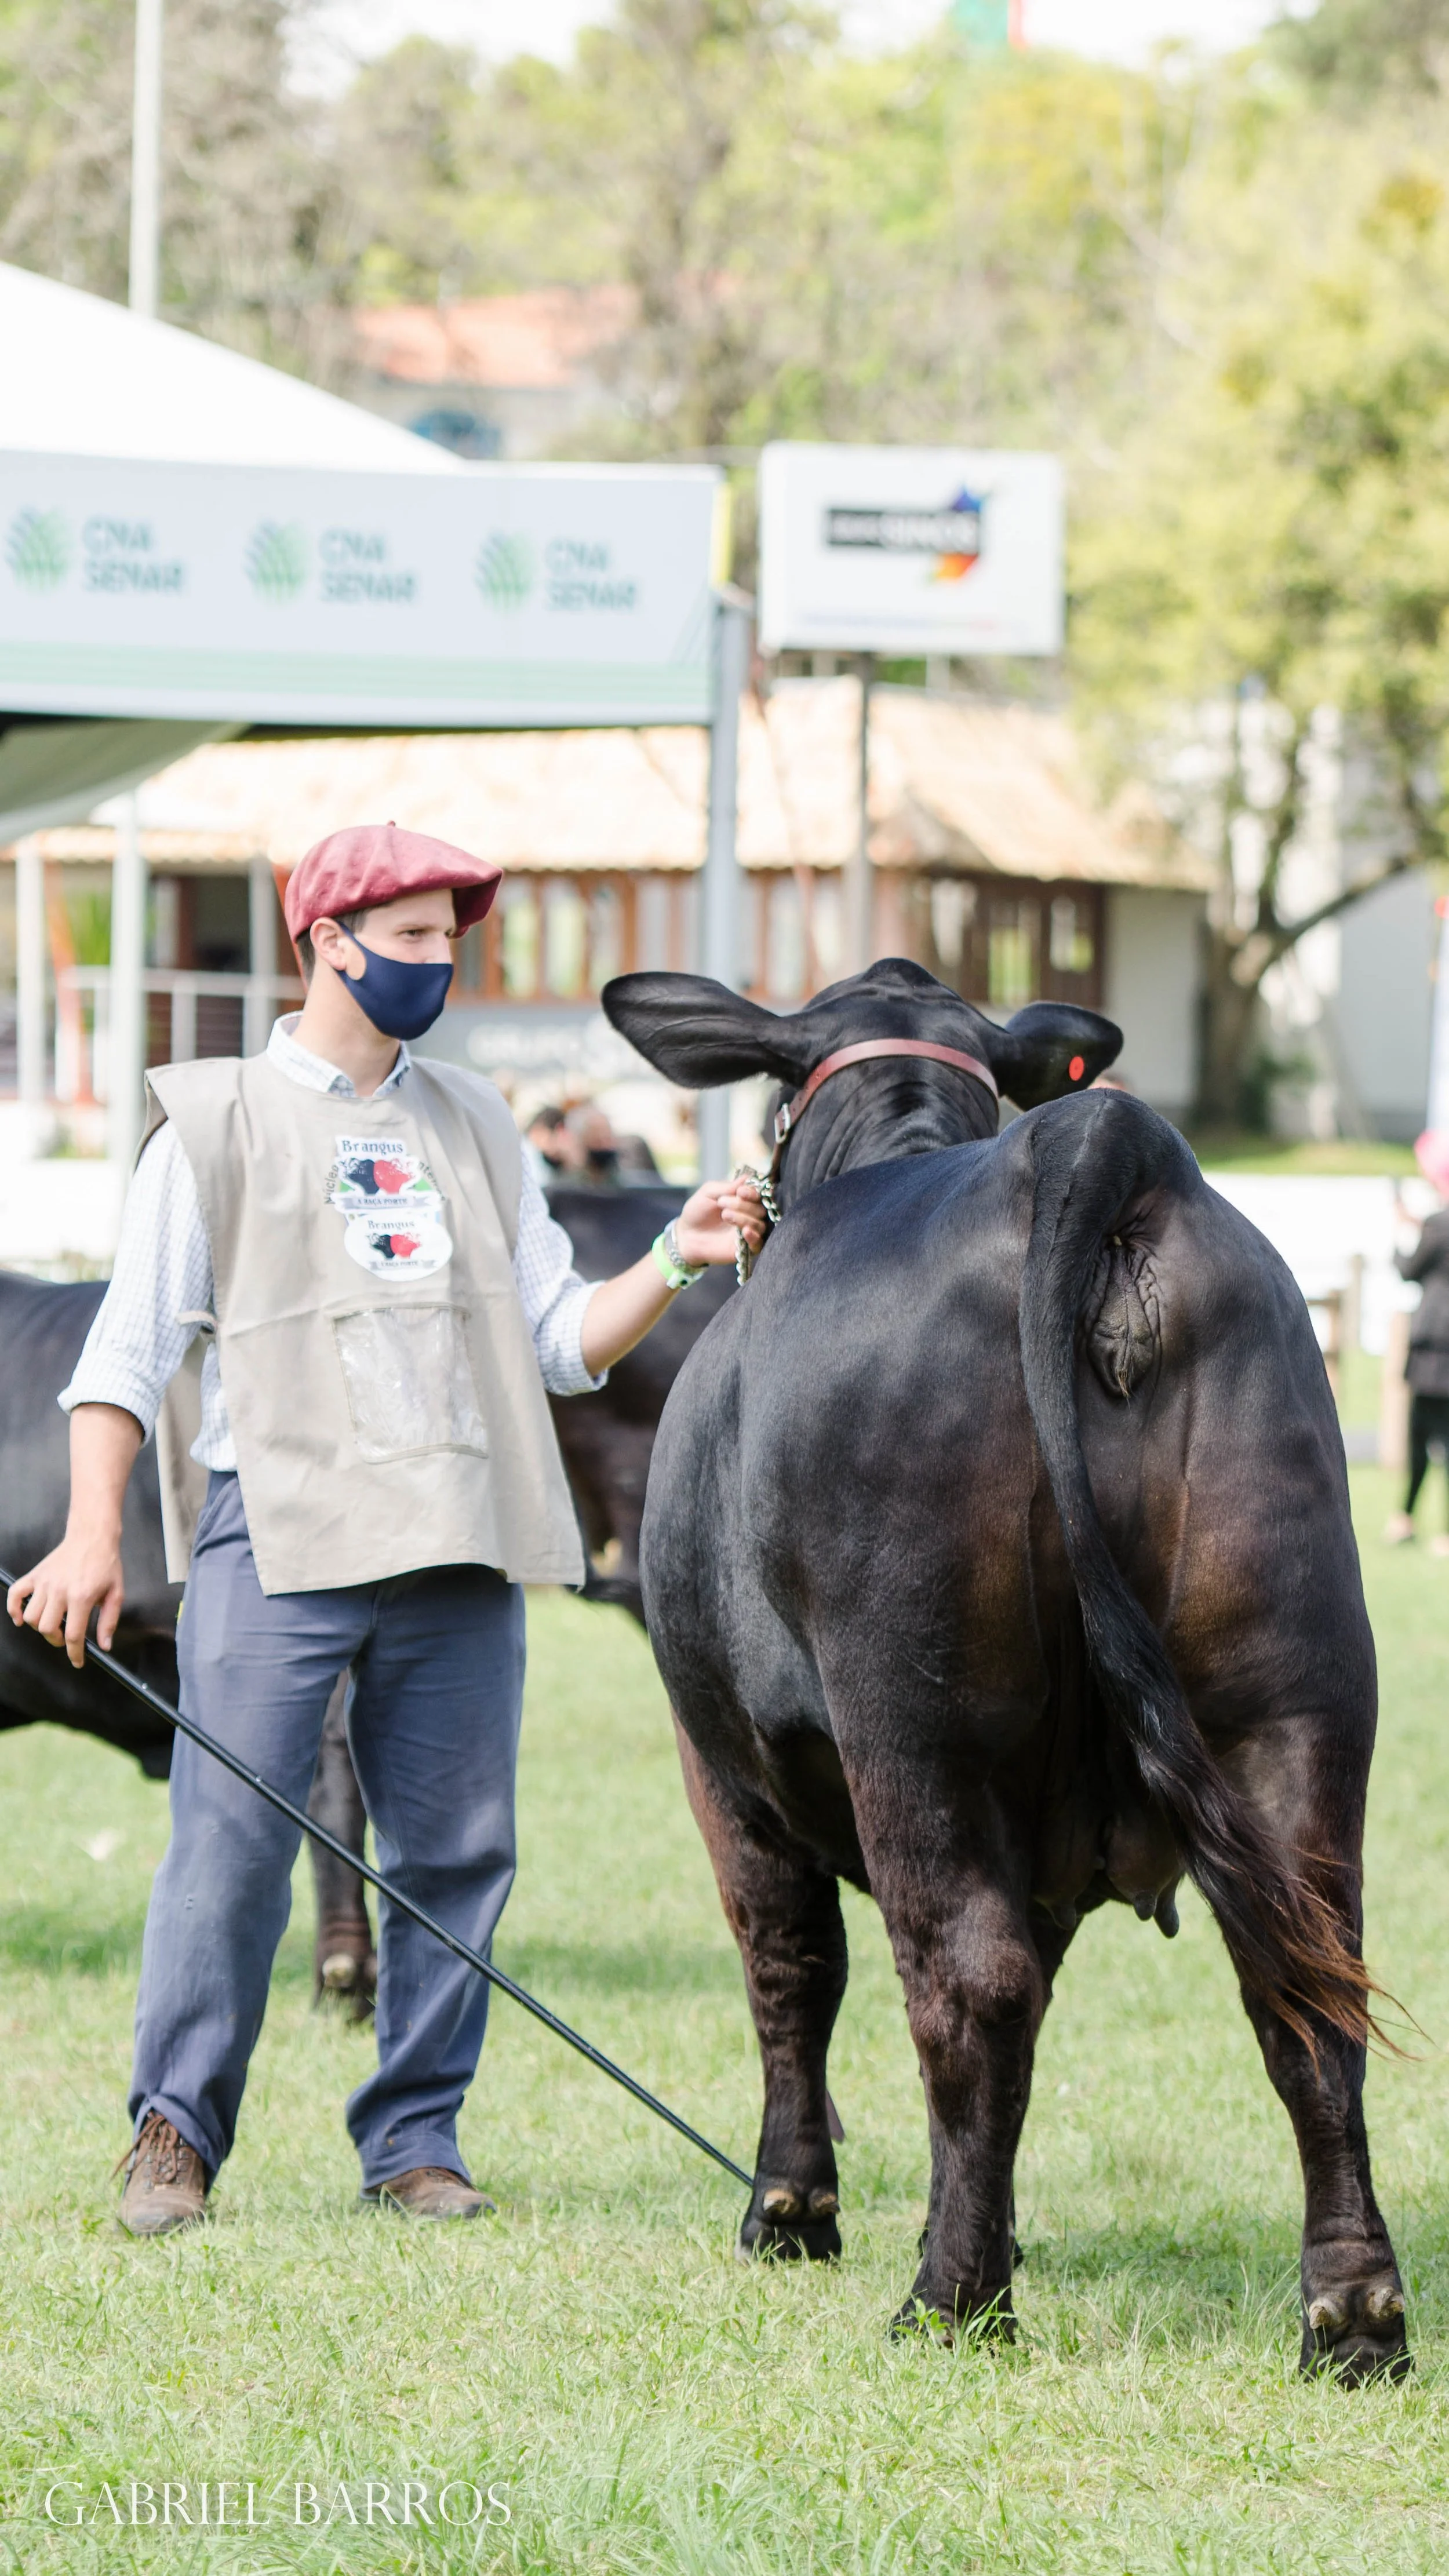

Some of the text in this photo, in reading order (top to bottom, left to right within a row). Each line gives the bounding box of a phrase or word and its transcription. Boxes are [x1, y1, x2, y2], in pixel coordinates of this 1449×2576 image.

[82, 516, 155, 554] CNA
[319, 527, 388, 566] CNA
[546, 538, 611, 573] CNA
[82, 558, 184, 594] SENAR
[319, 569, 417, 604] SENAR
[546, 580, 638, 612] SENAR
[341, 1140, 404, 1156] Brangus
[367, 1220, 416, 1230] Brangus
